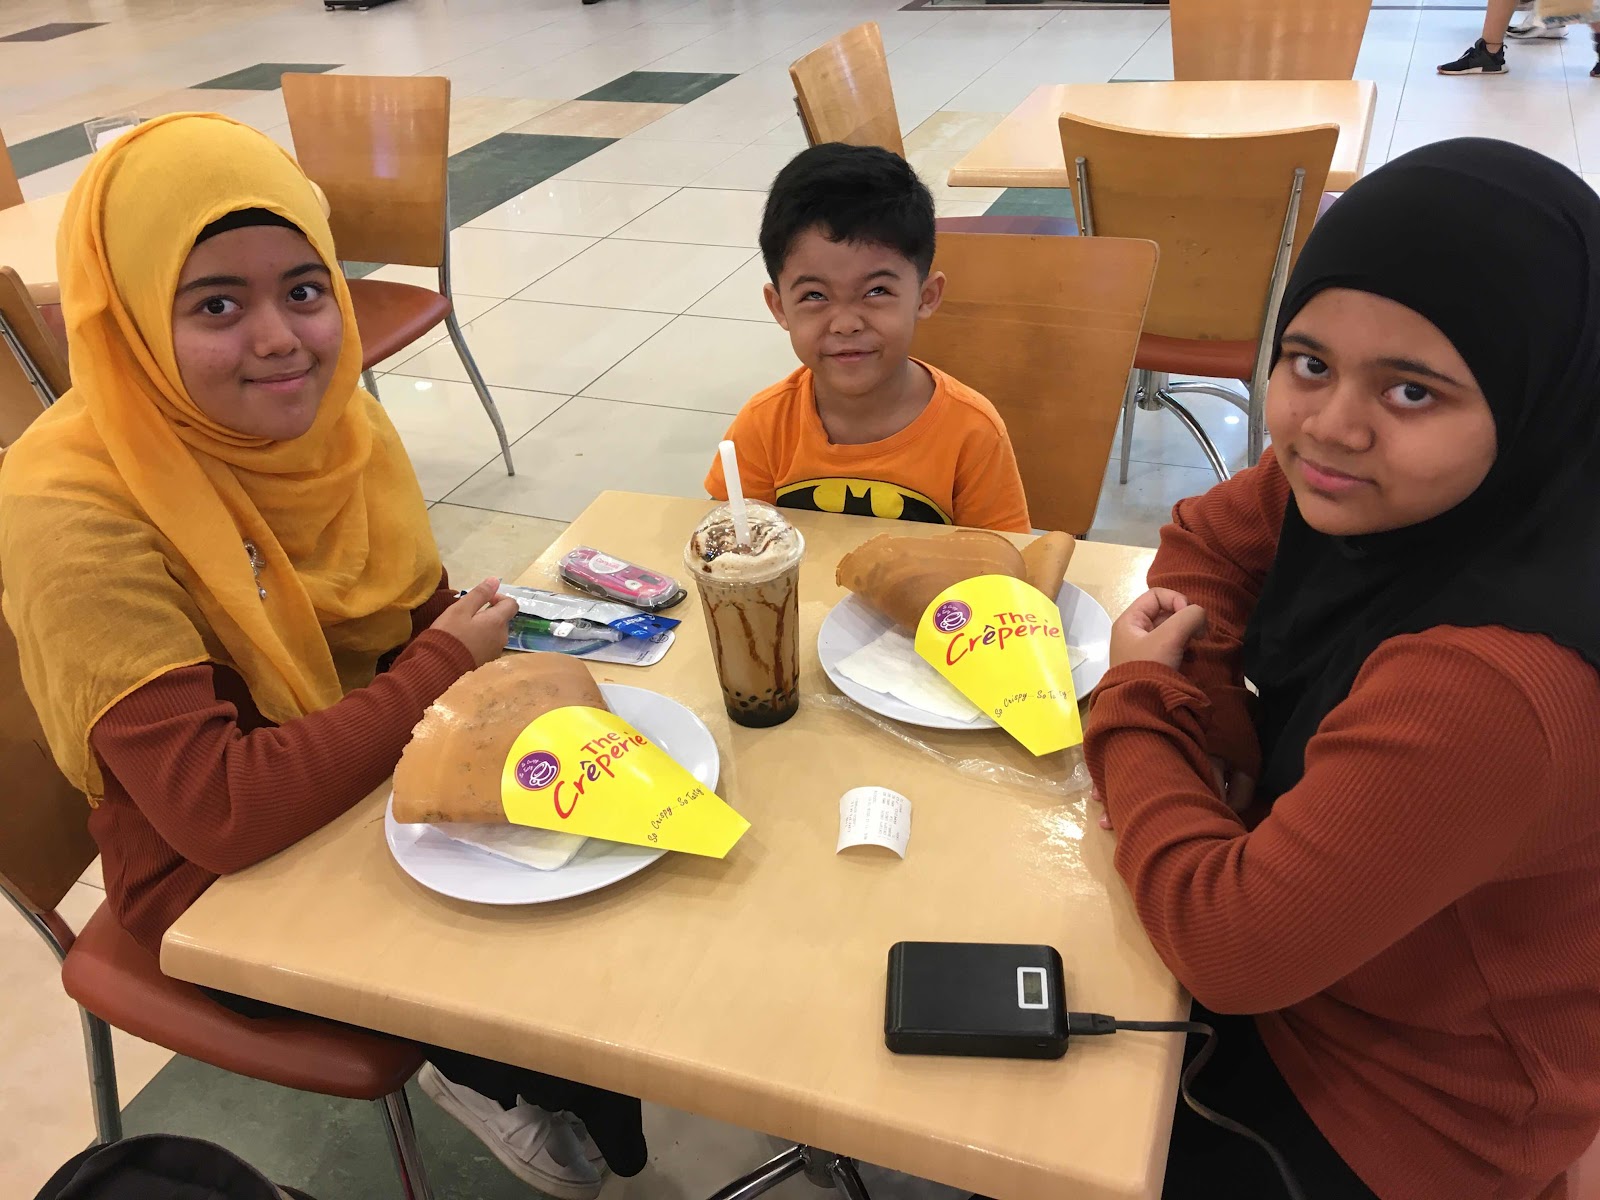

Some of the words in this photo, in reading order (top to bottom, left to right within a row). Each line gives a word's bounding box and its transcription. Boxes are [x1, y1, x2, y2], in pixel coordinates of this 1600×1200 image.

[993, 612, 1037, 625] The
[945, 618, 1061, 667] Crêperie
[995, 708, 1003, 718] So
[1036, 689, 1047, 699] So
[580, 732, 621, 755] The
[553, 731, 648, 820] Crêperie
[677, 796, 689, 807] So
